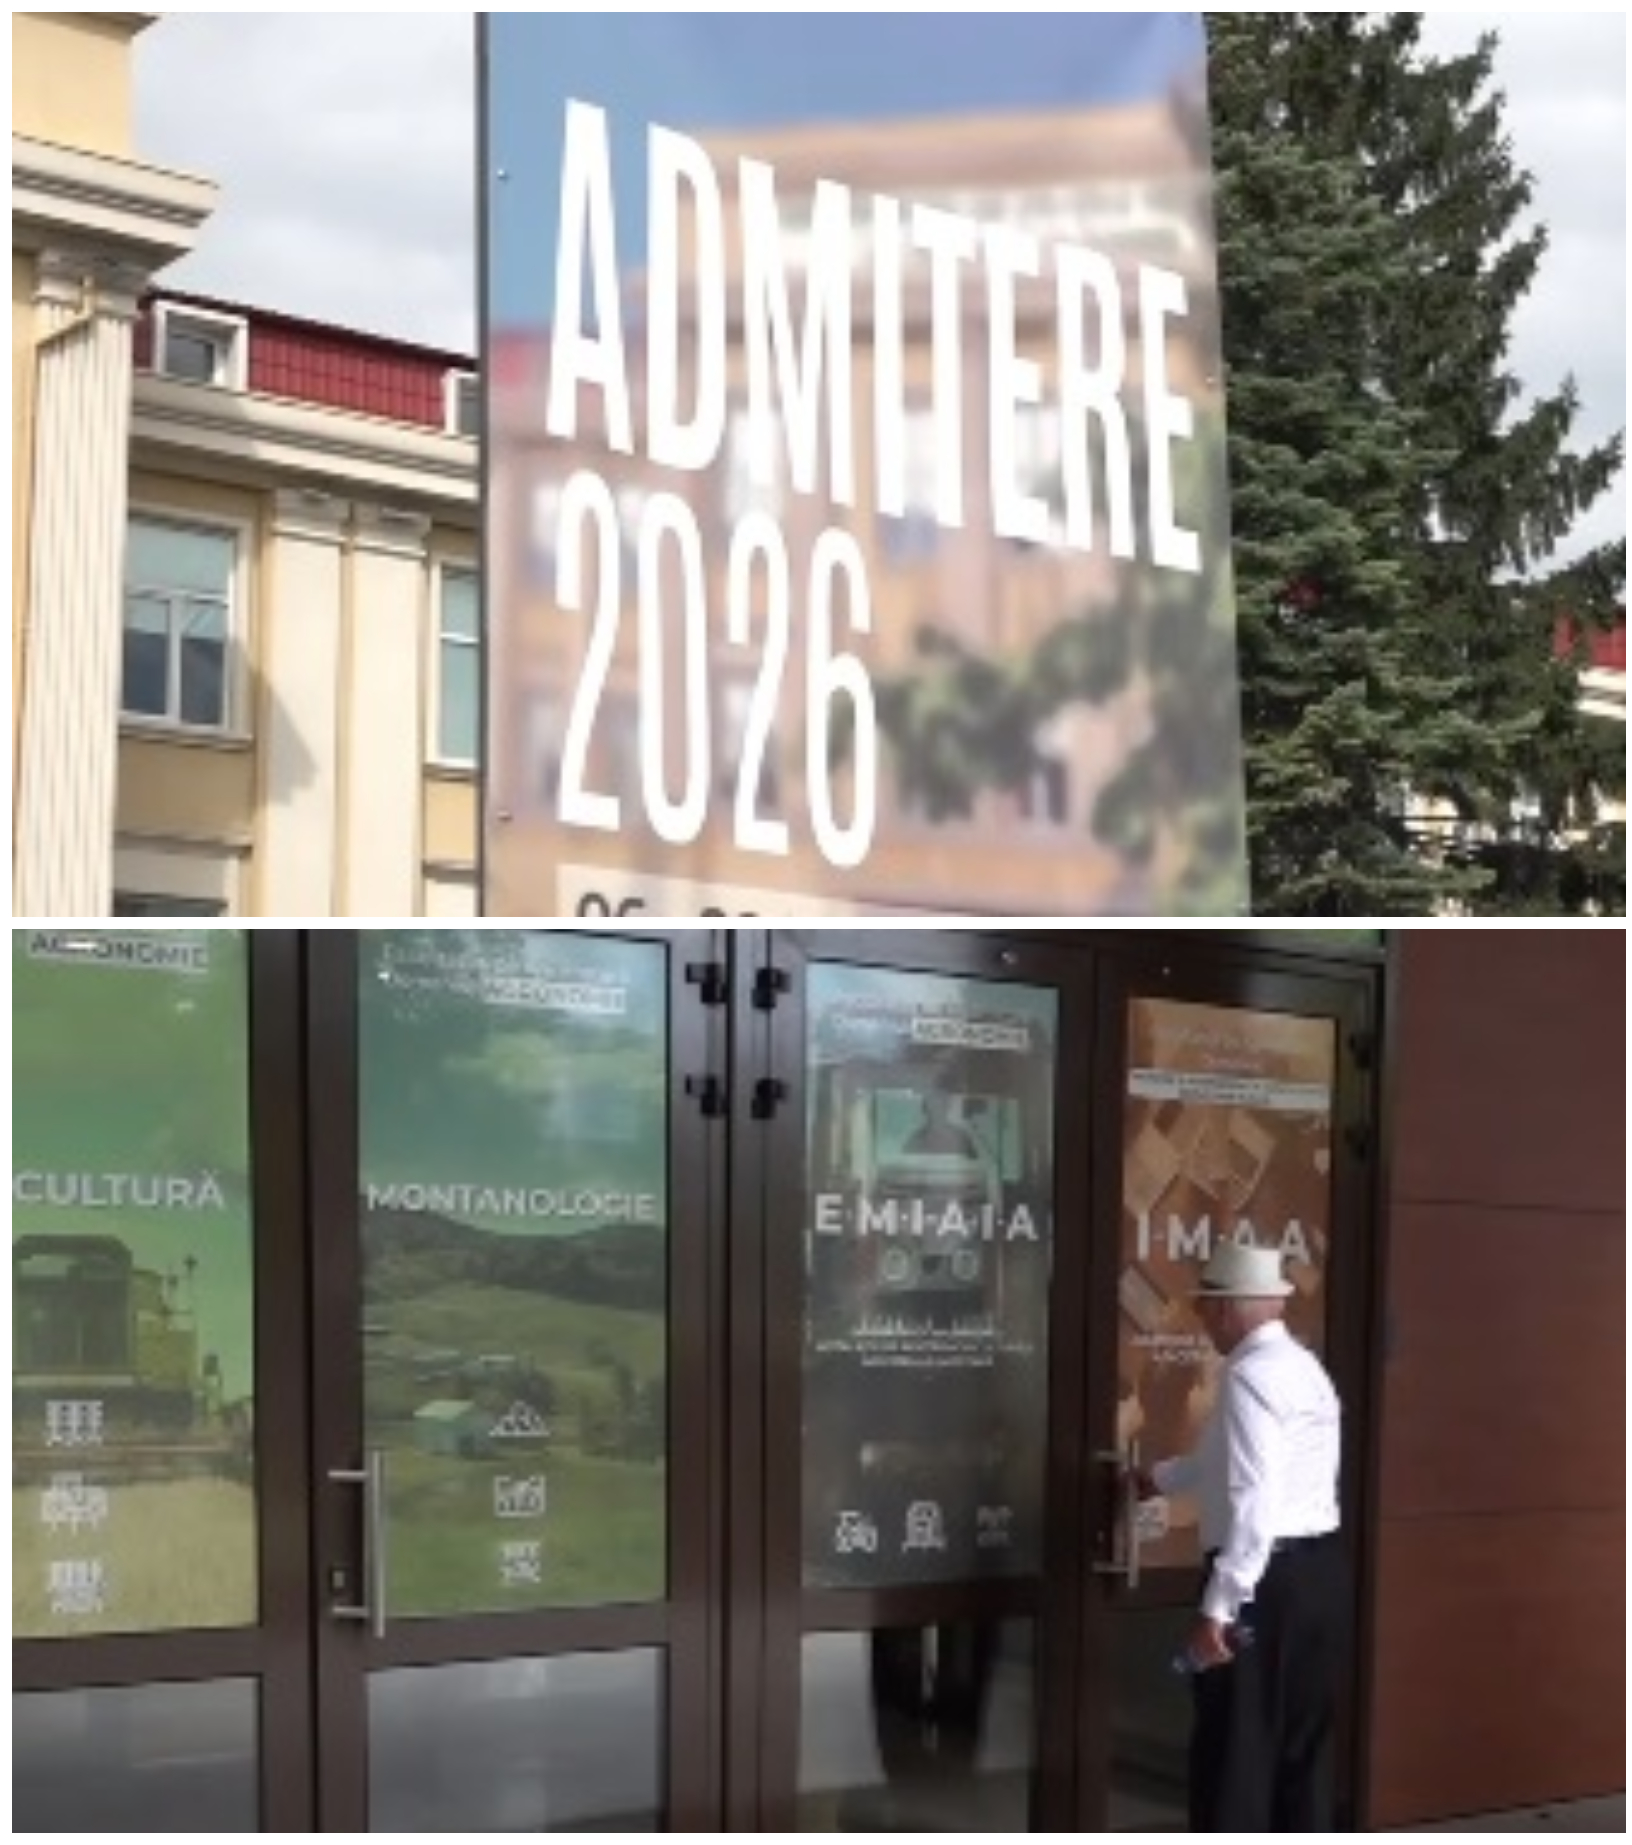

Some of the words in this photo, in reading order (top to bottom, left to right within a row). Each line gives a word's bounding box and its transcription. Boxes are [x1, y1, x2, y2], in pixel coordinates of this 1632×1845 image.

[546, 98, 1201, 574] ADMITERE
[556, 469, 877, 868] 2026
[365, 1181, 658, 1221] MONTANOLOGIE
